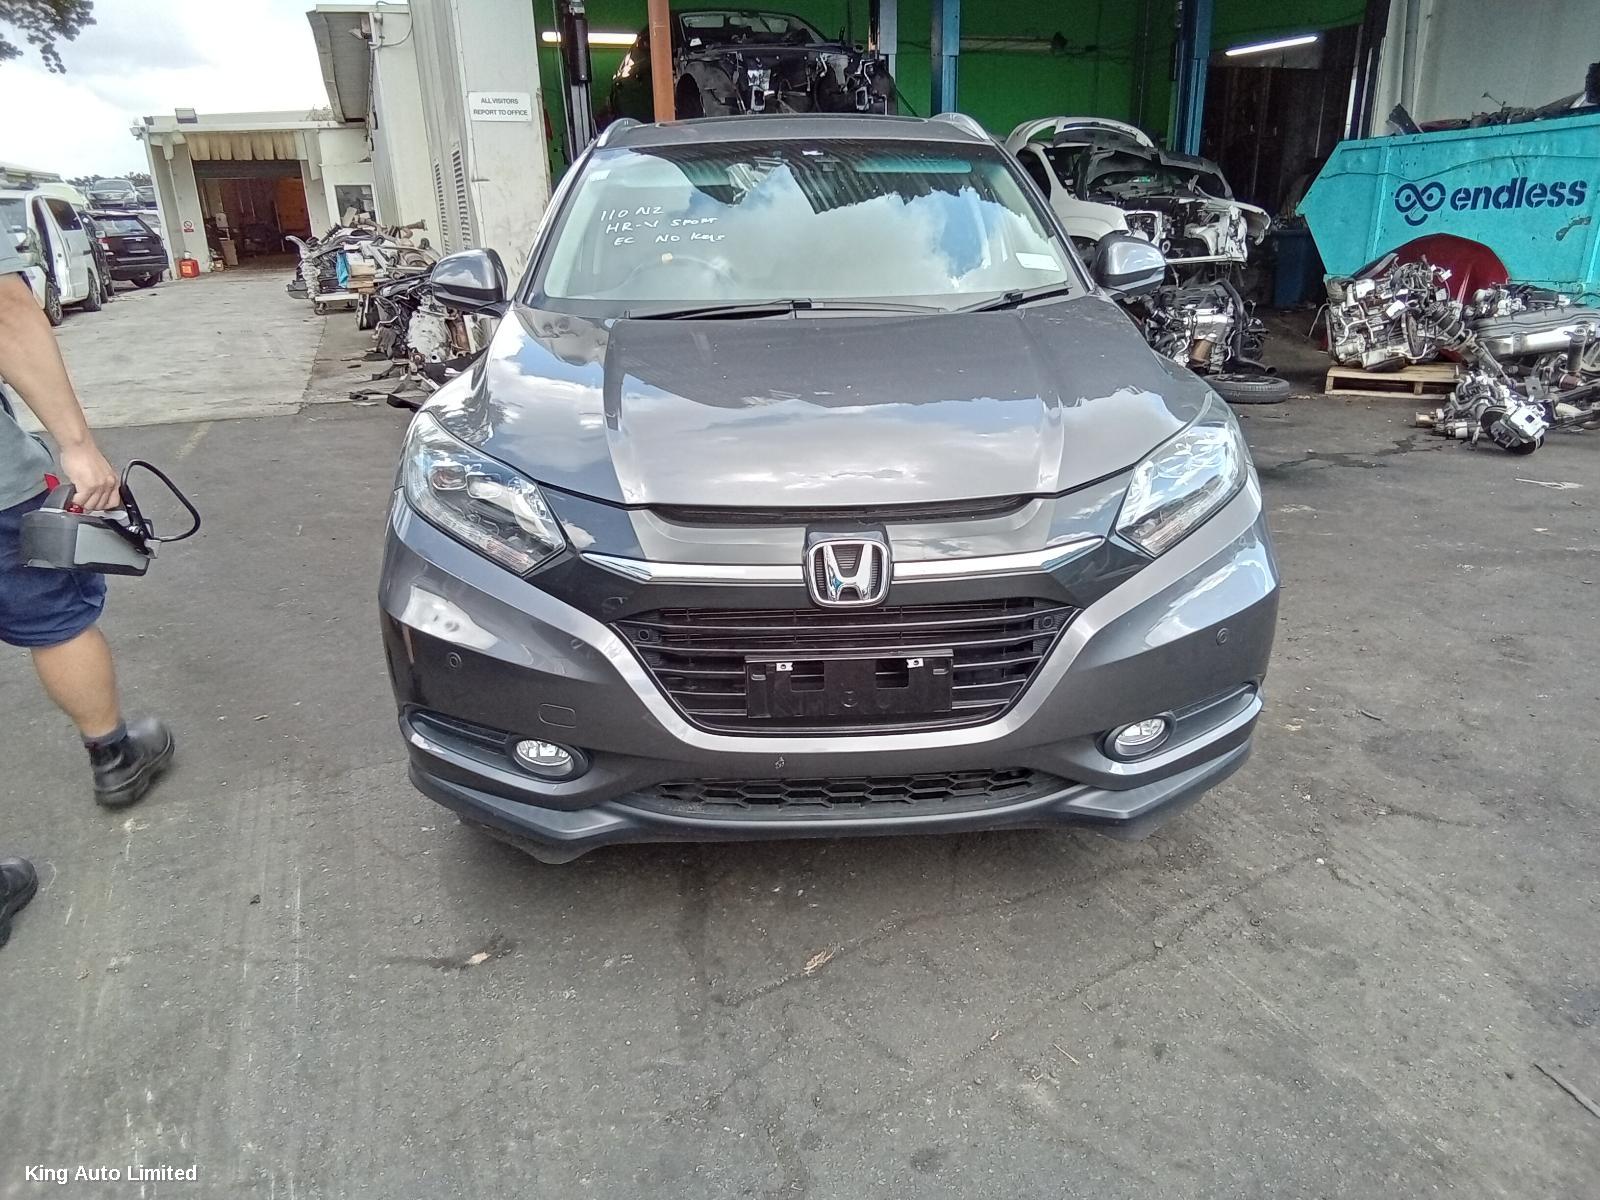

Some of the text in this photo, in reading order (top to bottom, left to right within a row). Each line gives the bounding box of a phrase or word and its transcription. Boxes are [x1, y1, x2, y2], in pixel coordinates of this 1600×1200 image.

[1450, 176, 1588, 211] endless
[600, 206, 664, 221] 110 NZ
[605, 220, 659, 234] HR-V
[614, 237, 636, 246] EC
[655, 234, 681, 243] NO
